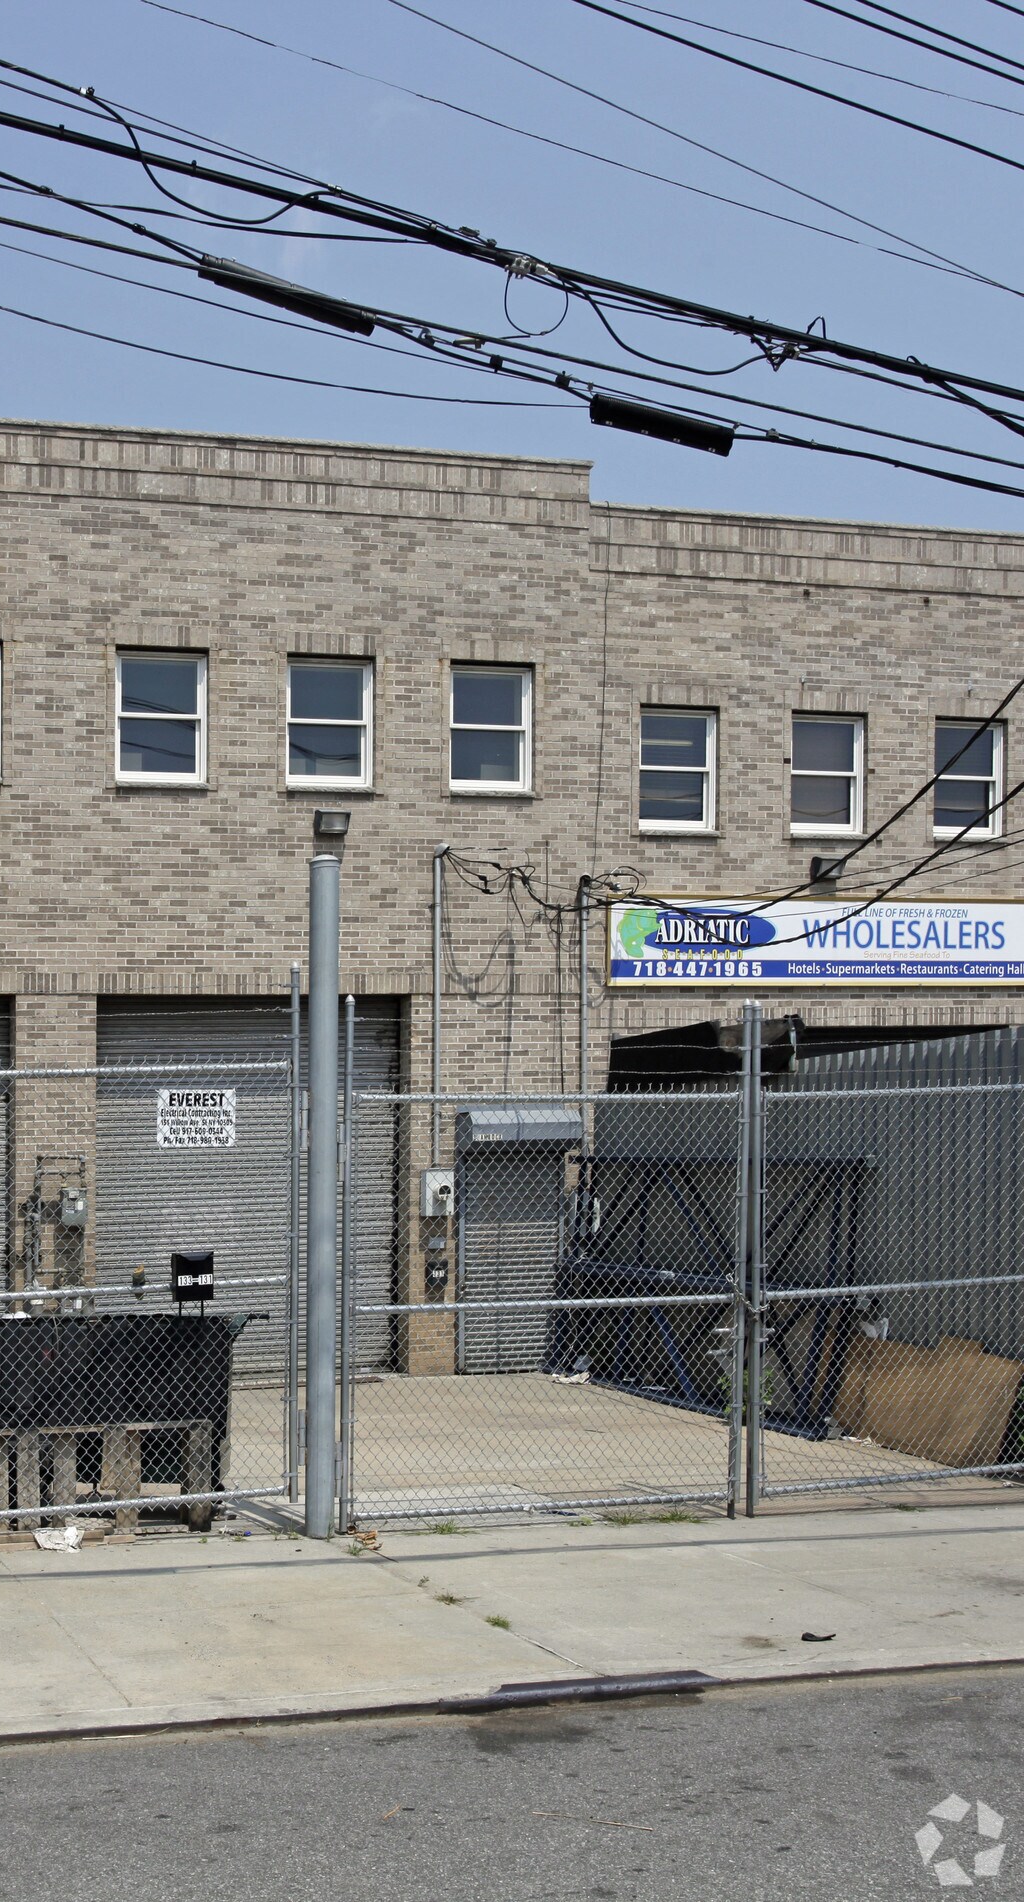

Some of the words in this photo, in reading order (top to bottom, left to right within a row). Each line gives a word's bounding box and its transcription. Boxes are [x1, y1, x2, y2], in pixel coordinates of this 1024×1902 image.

[864, 908, 883, 918] LINE
[885, 909, 897, 918] OF
[898, 908, 925, 918] FRESH
[926, 909, 934, 918] &
[934, 909, 969, 919] FROZEN
[655, 918, 749, 944] ADRIATIC
[802, 918, 1006, 950] WHOLESALERS
[863, 950, 892, 961] Serving
[893, 951, 908, 960] Fine
[909, 951, 941, 960] Seafood
[942, 950, 951, 960] To
[788, 962, 821, 975] Hotels
[825, 962, 896, 977] Supermarkets
[900, 963, 959, 976] Restaurants
[963, 963, 1005, 978] Catering
[169, 1092, 225, 1107] EVEREST
[188, 1108, 221, 1119] Contracting
